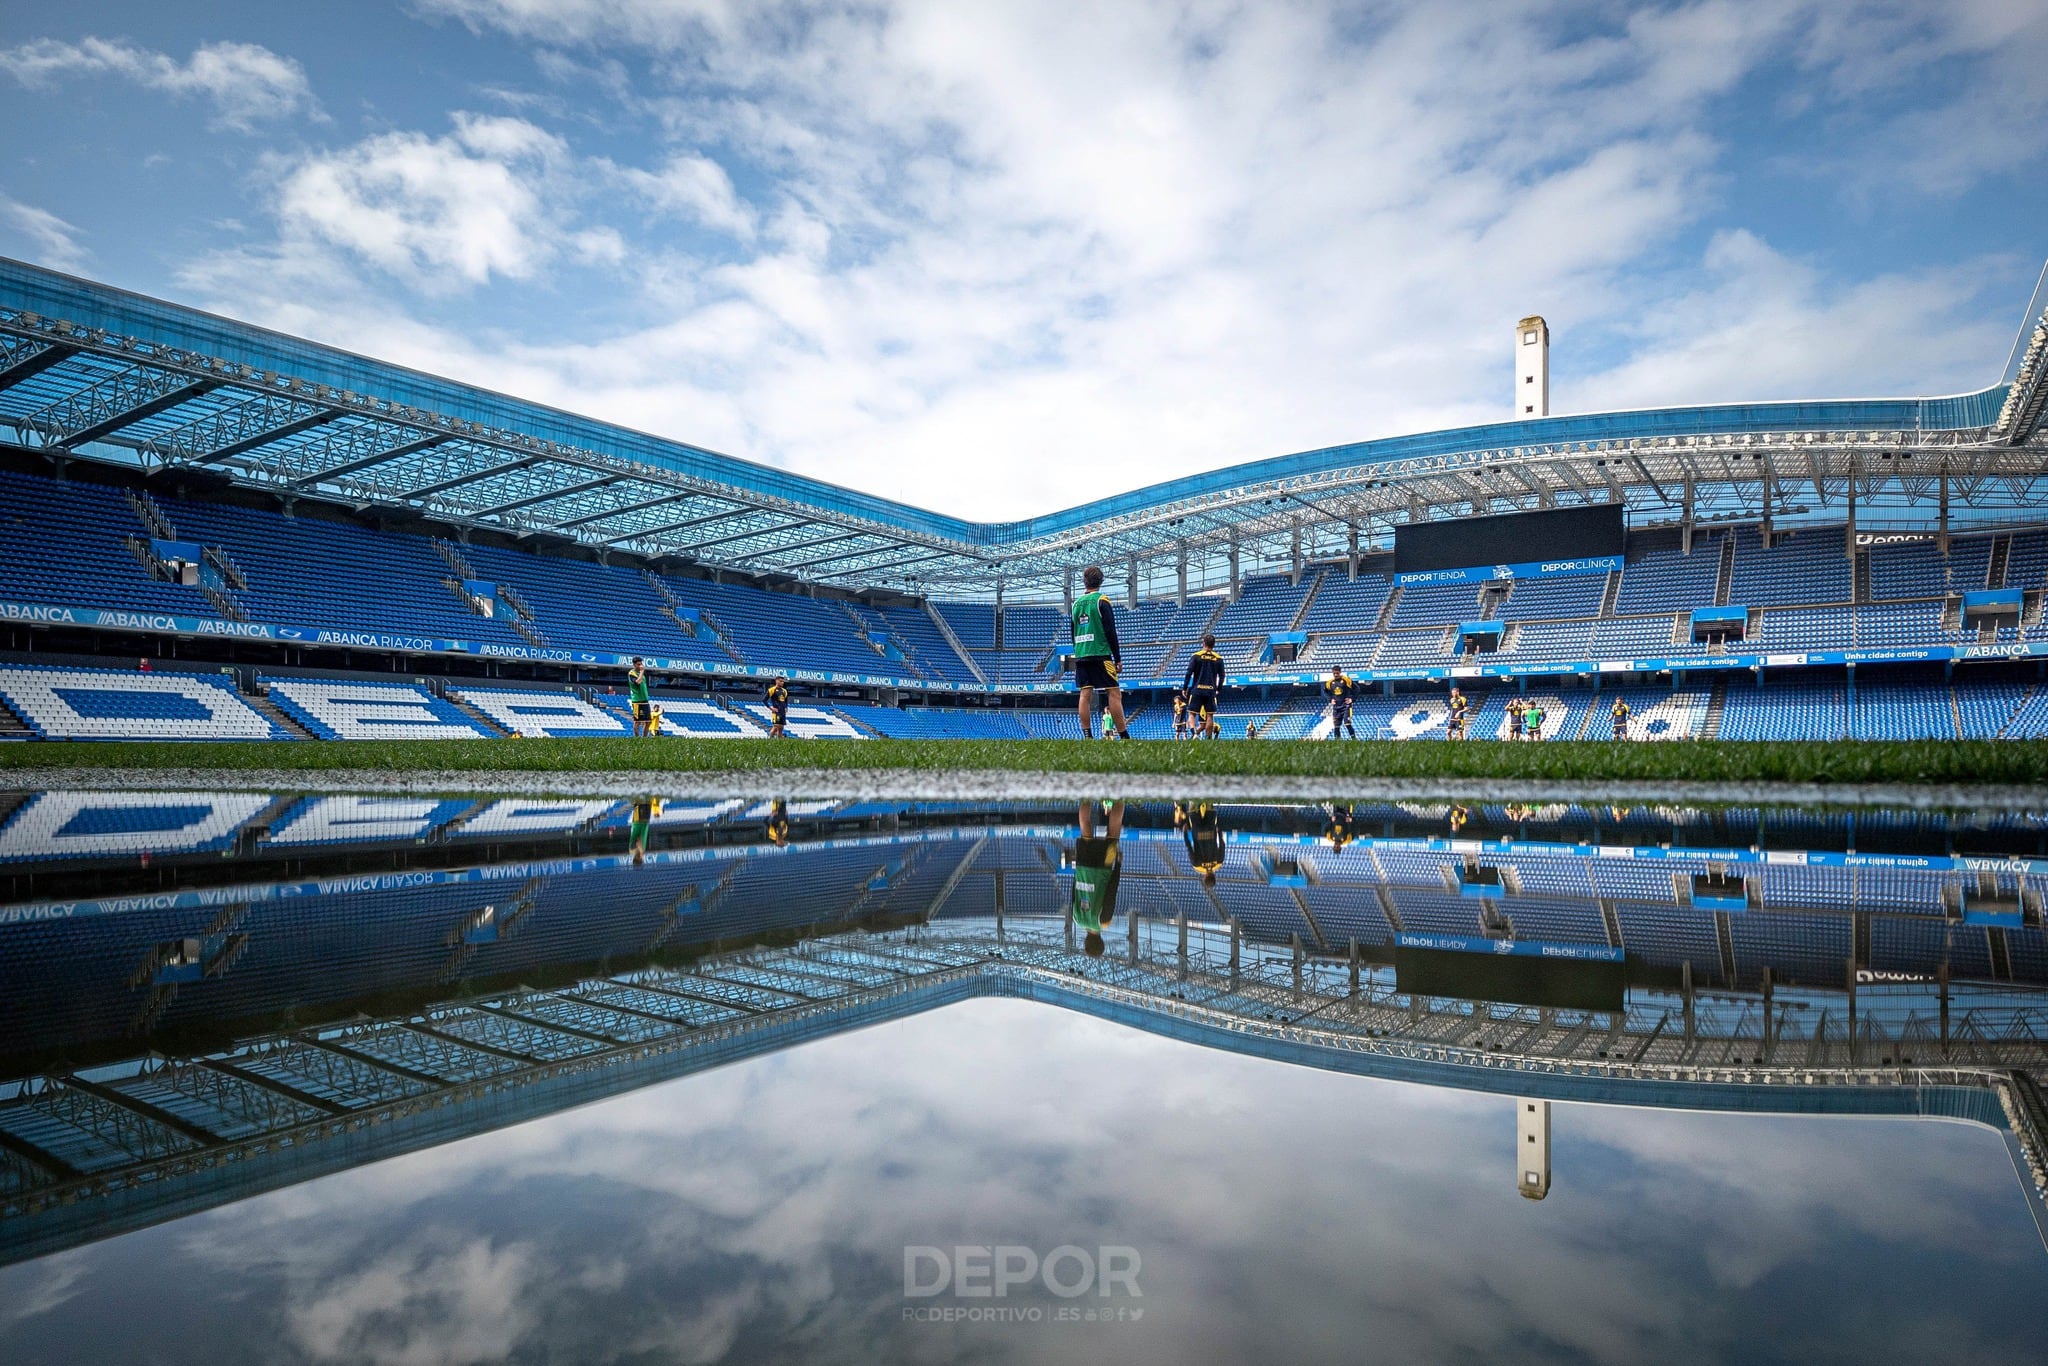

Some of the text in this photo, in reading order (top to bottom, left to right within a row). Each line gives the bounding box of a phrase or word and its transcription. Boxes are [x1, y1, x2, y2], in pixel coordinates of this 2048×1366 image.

[1541, 559, 1616, 572] DEPORCLÍNICA
[1400, 570, 1466, 583] DEPORTIENDA
[381, 636, 433, 650] RIAZOR
[530, 648, 572, 661] RIAZOR
[1868, 651, 1895, 660] cidade
[1897, 650, 1928, 660] contigo
[1550, 664, 1574, 673] contigo
[1686, 659, 1710, 667] cidade
[1711, 658, 1738, 667] contigo
